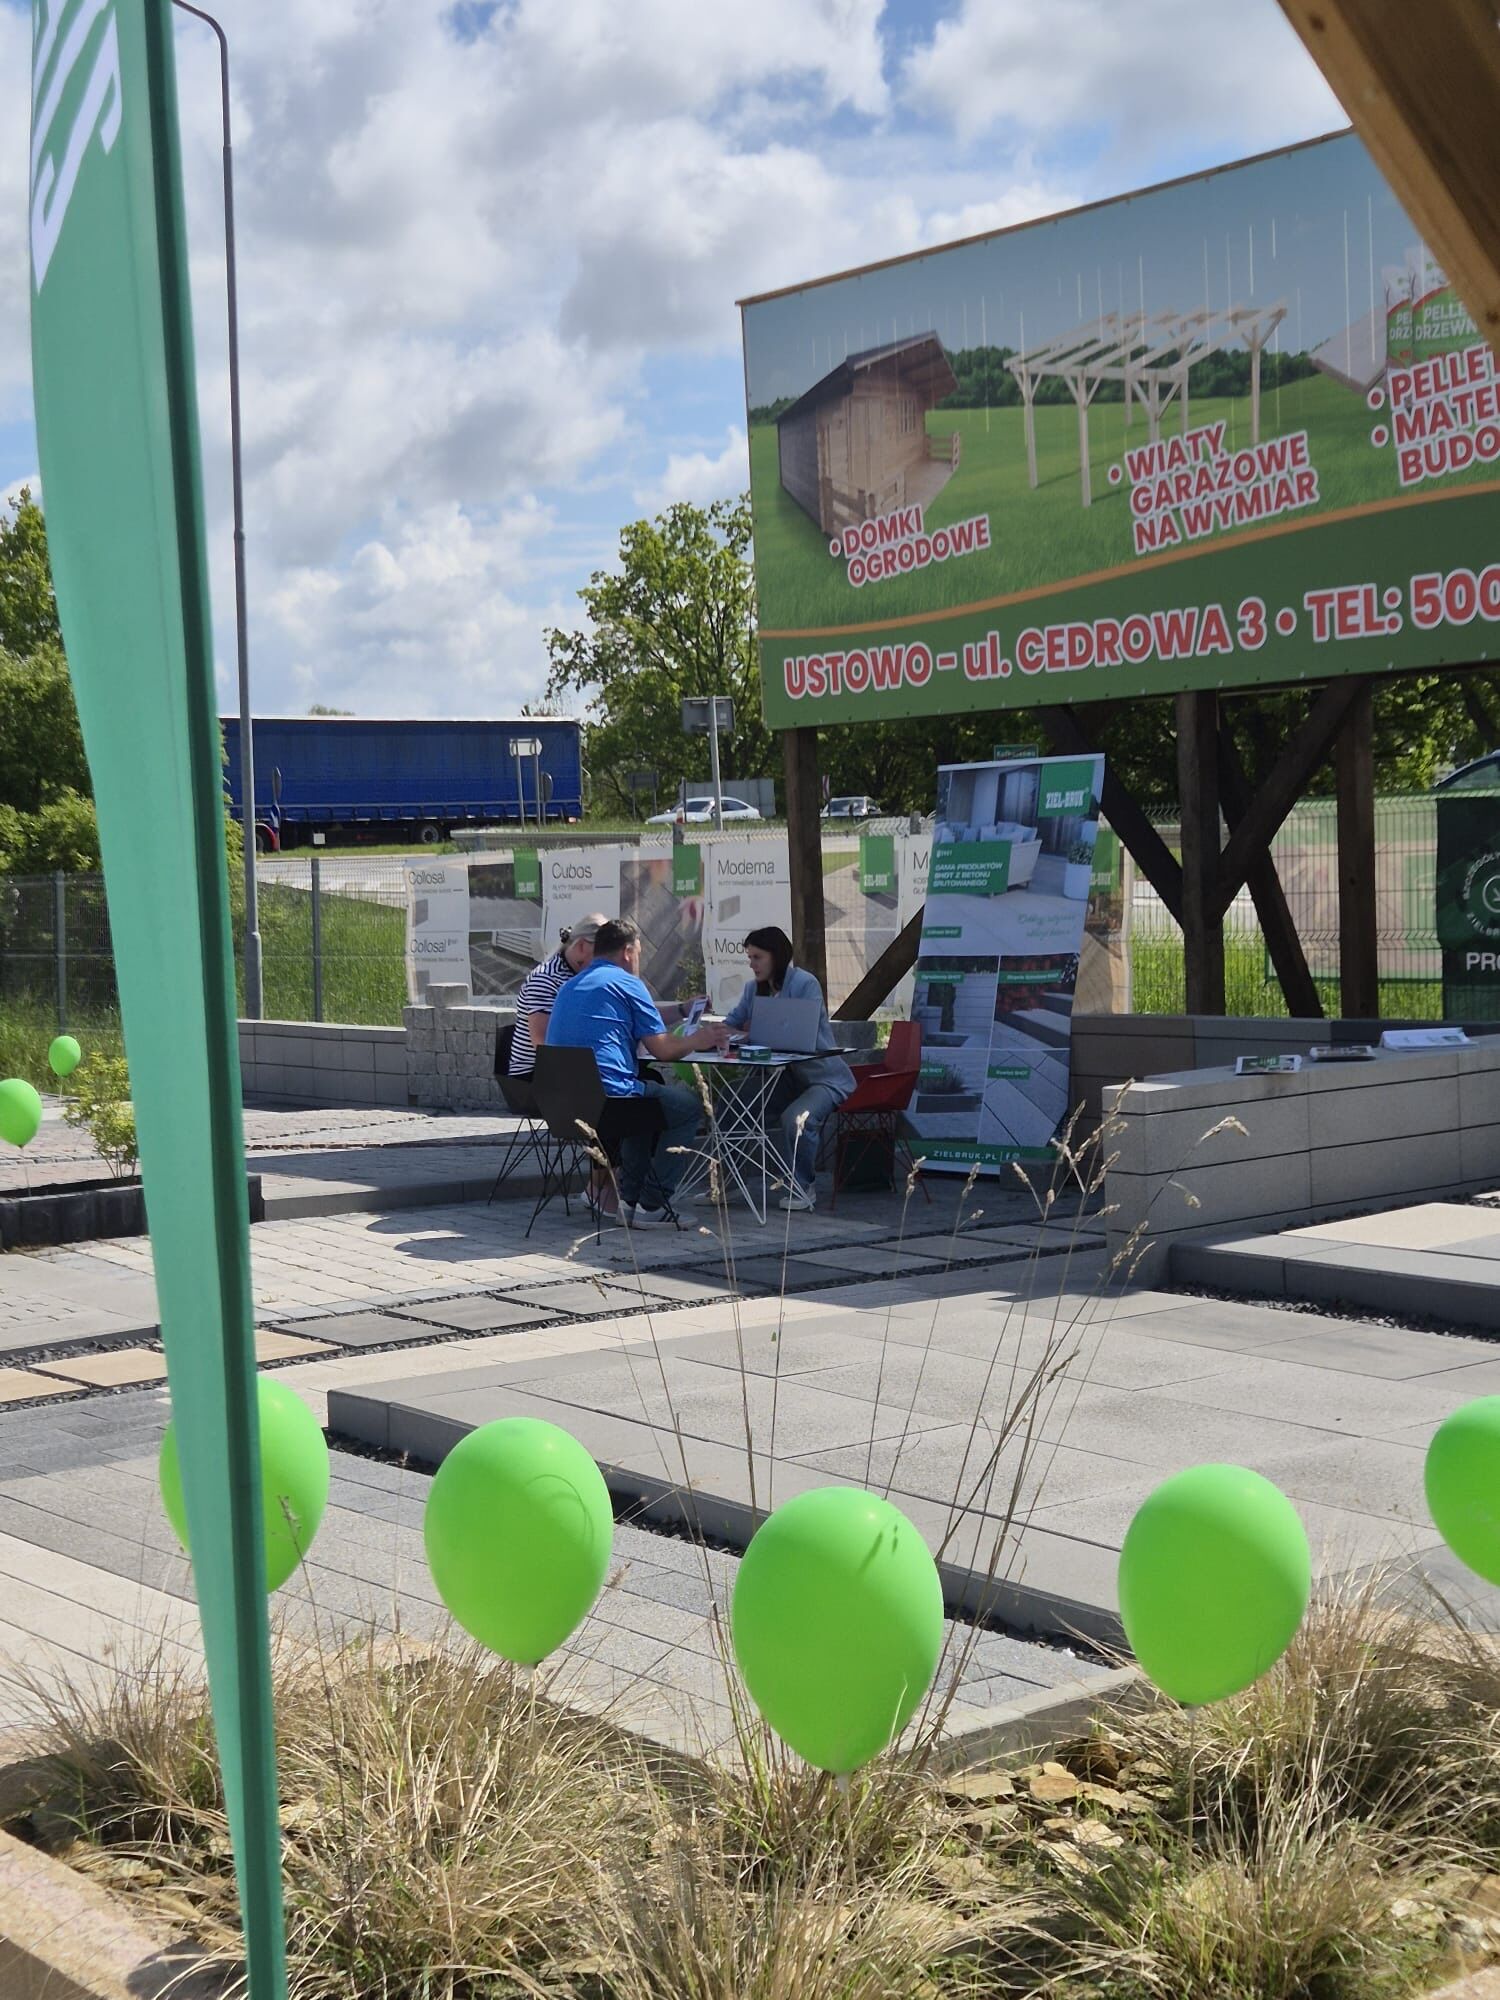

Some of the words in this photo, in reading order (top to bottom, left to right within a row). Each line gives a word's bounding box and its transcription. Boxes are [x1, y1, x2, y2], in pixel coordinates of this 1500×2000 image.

[1394, 383, 1500, 446] MATE
[1126, 421, 1225, 482] WIATY
[1131, 432, 1307, 516] GARAŻOWE
[844, 506, 922, 557] DOMKI
[1135, 513, 1181, 553] NA
[1183, 469, 1318, 540] WYMIAR
[849, 516, 989, 586] OGRODOWE
[785, 643, 931, 698] USTOWO
[964, 632, 1012, 679] ul.
[1017, 604, 1232, 674] CEDROWA
[1237, 597, 1267, 649] 3
[1304, 585, 1402, 641] TEL:
[1045, 790, 1085, 809] ZIEL-BRUK
[552, 863, 592, 879] Cubos
[933, 1150, 998, 1161] ZIELBRUK.PL
